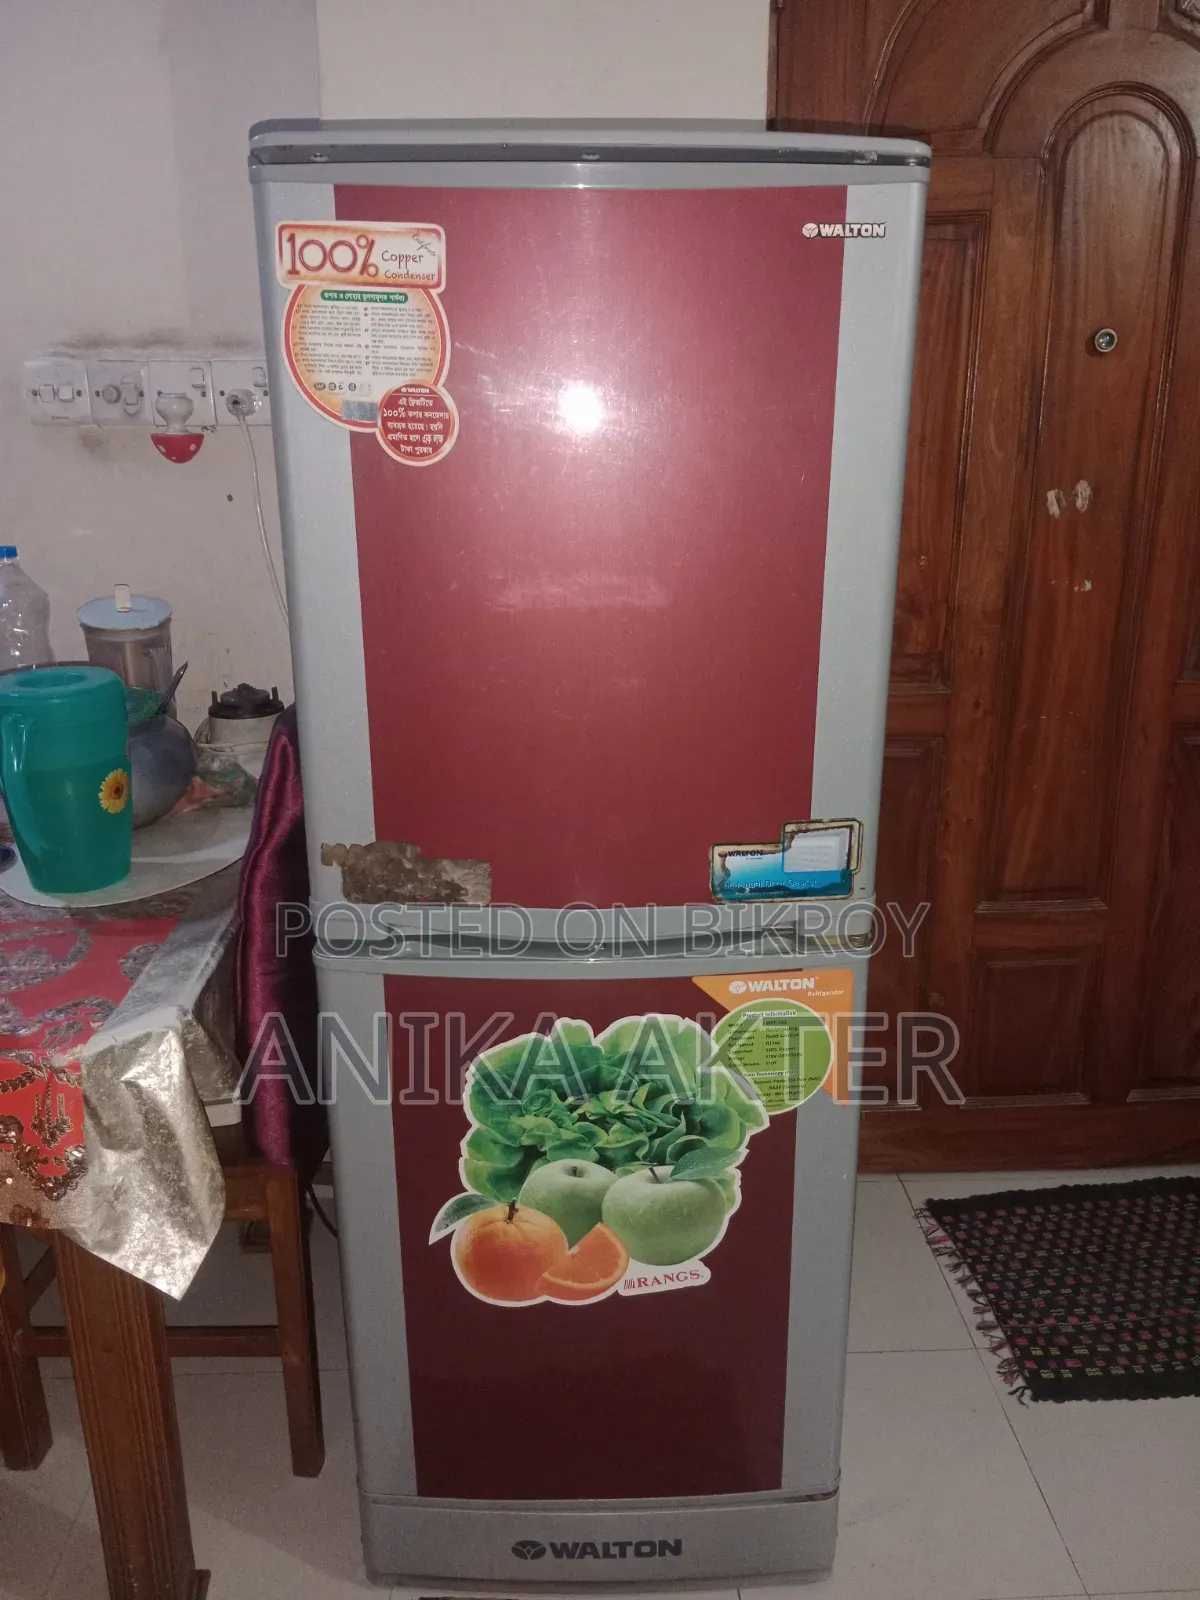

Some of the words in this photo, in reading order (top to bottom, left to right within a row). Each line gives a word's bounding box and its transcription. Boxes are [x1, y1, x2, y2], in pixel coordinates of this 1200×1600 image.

[818, 223, 886, 238] WALTON
[286, 232, 379, 278] 100%
[381, 250, 425, 270] Copper
[384, 270, 436, 281] Condenser
[748, 977, 815, 992] WALTON
[807, 989, 844, 997] Refrigerator
[637, 1269, 701, 1288] RANGS
[548, 1539, 683, 1560] WALTON
